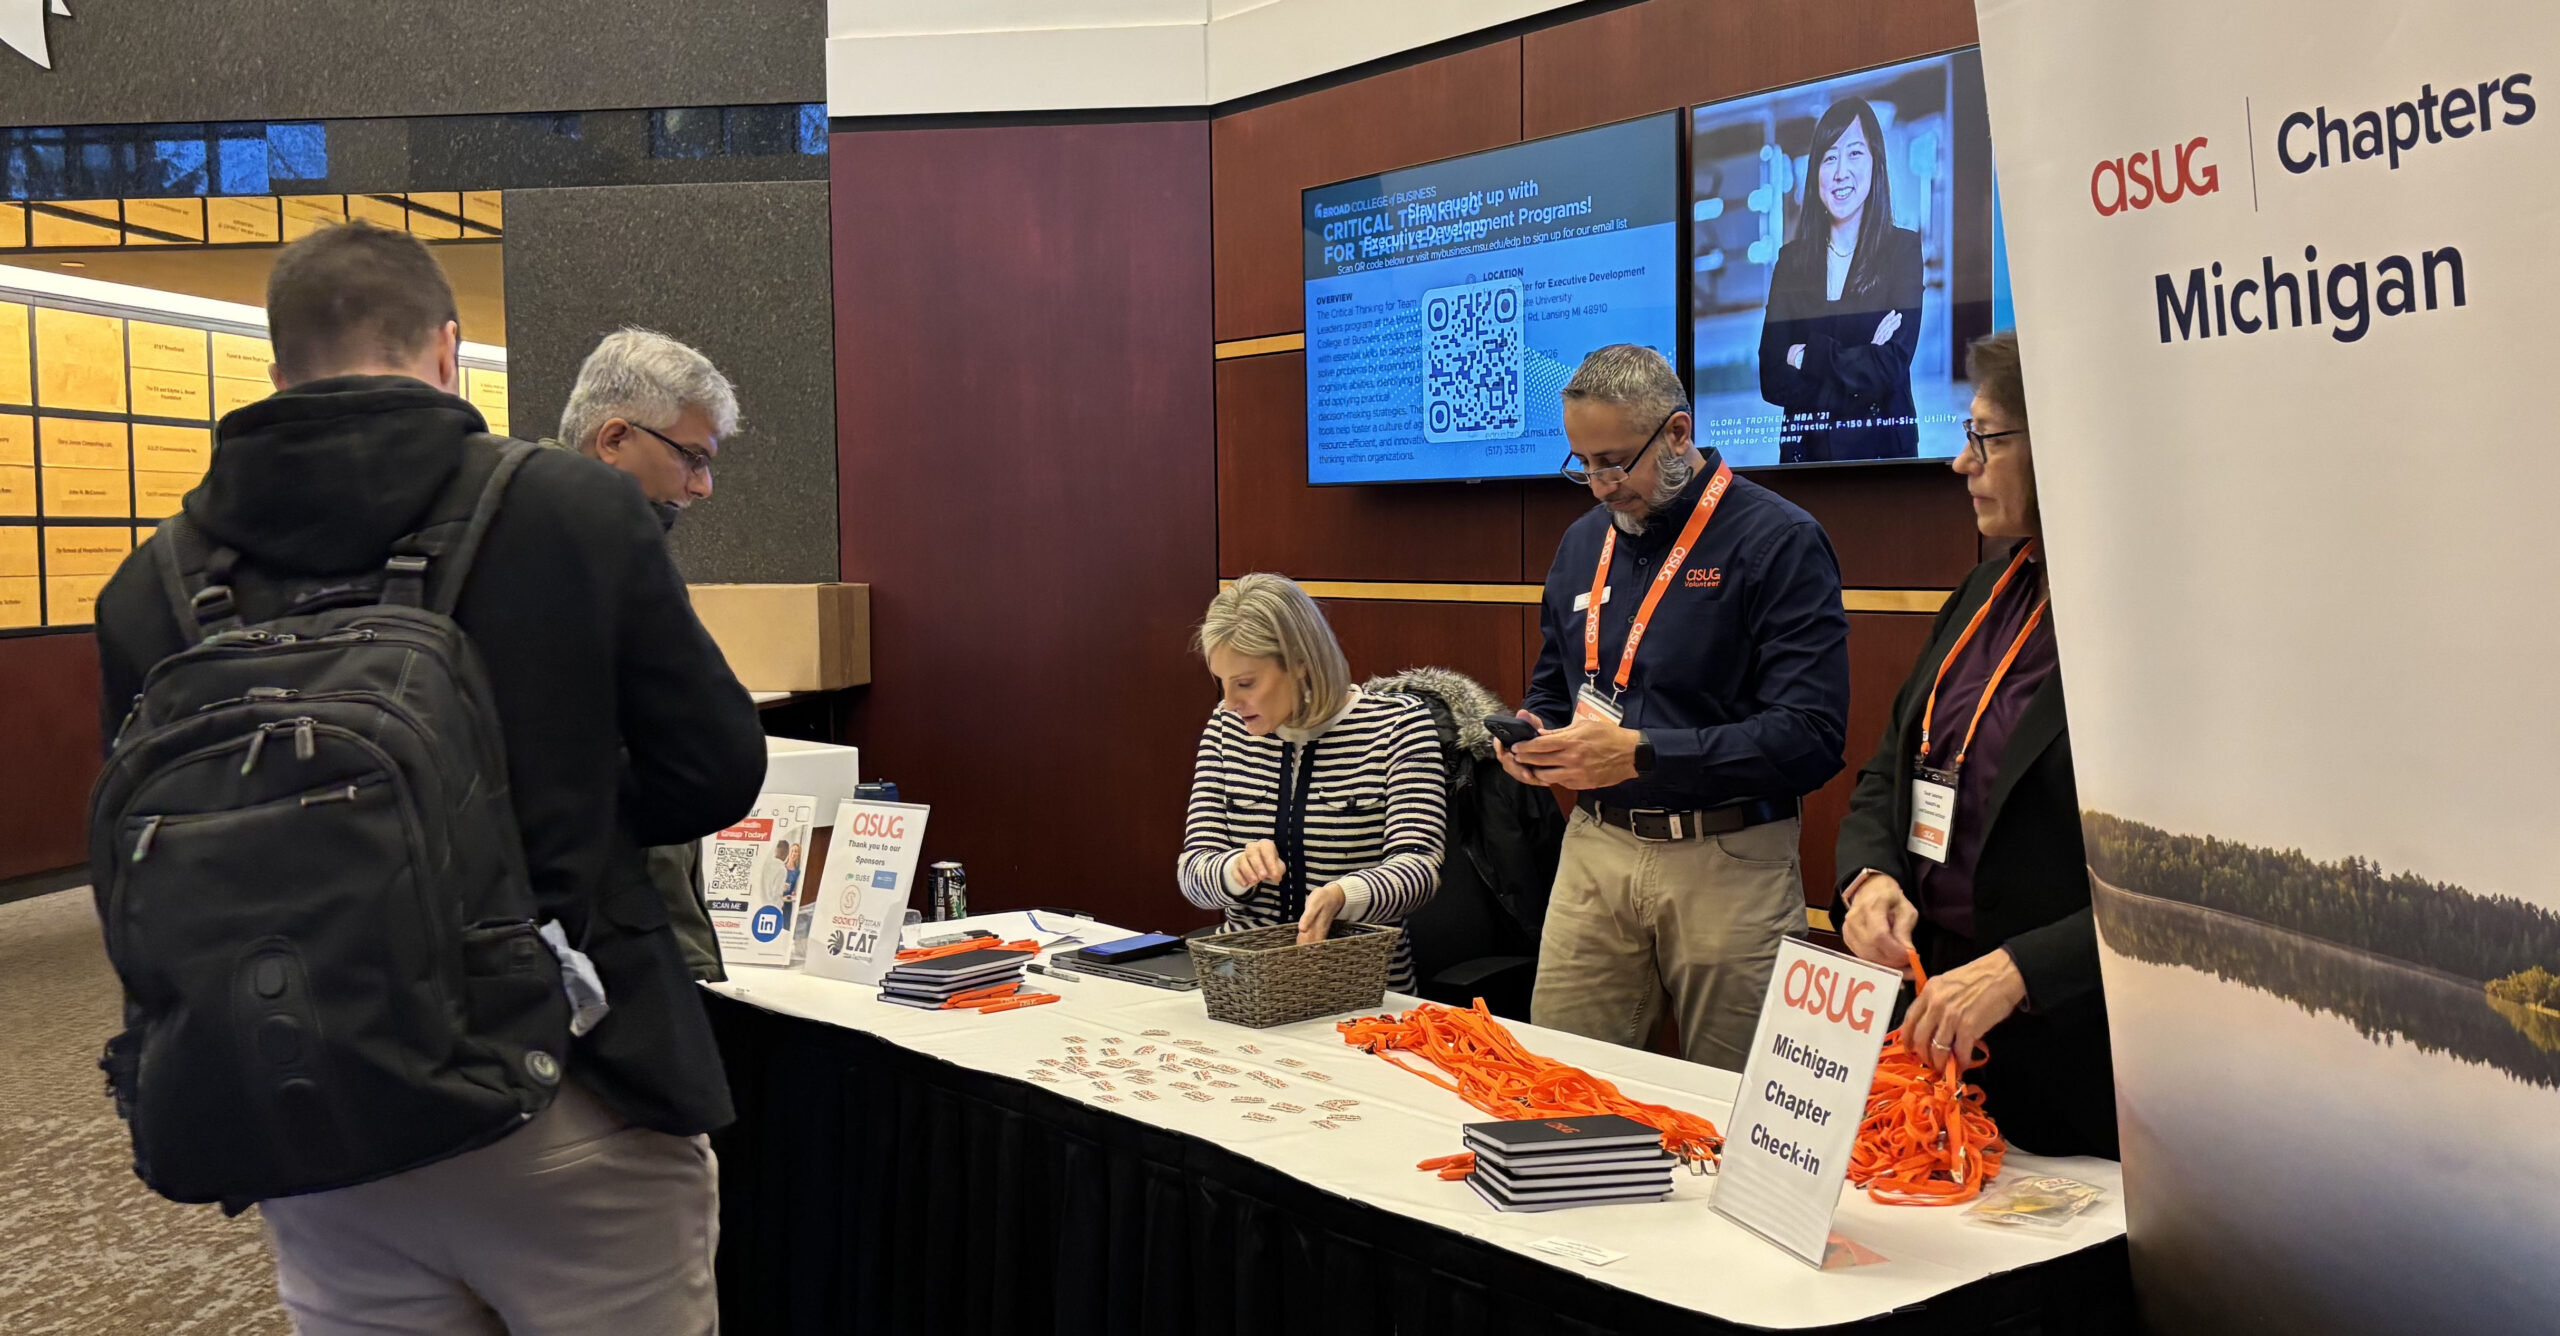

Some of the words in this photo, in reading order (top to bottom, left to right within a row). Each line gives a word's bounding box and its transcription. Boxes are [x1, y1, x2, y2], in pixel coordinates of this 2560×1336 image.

[2277, 72, 2537, 175] Chapters
[1323, 204, 1349, 218] BROAD
[1351, 195, 1388, 212] COLLEGE
[1396, 186, 1437, 204] BUSINESS
[1438, 190, 1483, 215] caught
[1486, 189, 1504, 207] up
[1508, 179, 1538, 201] with
[1324, 213, 1394, 241] CRITICAL
[1364, 228, 1423, 251] Executive
[1426, 211, 1515, 242] Development
[1518, 196, 1592, 225] Programs!
[1324, 242, 1355, 265] FOR
[1338, 264, 1353, 275] Scan
[1354, 261, 1365, 272] QR
[1366, 258, 1384, 270] code
[1384, 255, 1405, 268] below
[1407, 255, 1414, 264] or
[1415, 251, 1429, 263] visit
[1522, 235, 1531, 246] to
[1532, 232, 1549, 245] sign
[1550, 231, 1561, 242] up
[1563, 227, 1574, 239] for
[1577, 226, 1590, 237] our
[1592, 220, 1614, 234] email
[1616, 218, 1628, 230] list
[1483, 267, 1524, 282] LOCATION
[1535, 279, 1546, 290] for
[1548, 275, 1587, 289] Executive
[1589, 266, 1646, 283] Development
[1316, 293, 1353, 305] OVERVIEW
[1535, 292, 1573, 306] University
[2155, 244, 2467, 344] Michigan
[1541, 309, 1570, 321] Lansing
[1571, 306, 1581, 316] MI
[1710, 418, 1742, 427] GLORIA
[1794, 412, 1813, 422] MBA
[1710, 427, 1742, 437] Vehicle
[1790, 422, 1833, 432] Director,
[1836, 418, 1863, 429] F-150
[1876, 415, 1920, 427] Full-Size
[1924, 413, 1957, 424] Utility
[1485, 446, 1503, 457] (517)
[1504, 443, 1536, 455] 353-8711
[1710, 438, 1730, 447] Ford
[1733, 437, 1759, 446] Motor
[848, 839, 867, 849] Thank
[868, 842, 881, 851] you
[881, 843, 888, 851] to
[889, 845, 901, 853] our
[855, 856, 886, 866] Sponsors
[712, 901, 730, 910] SCAN
[730, 902, 742, 910] ME
[845, 931, 878, 955] CAT
[1772, 1033, 1849, 1084] Michigan
[1764, 1080, 1832, 1127] Chapter
[1751, 1123, 1820, 1176] Check-in
